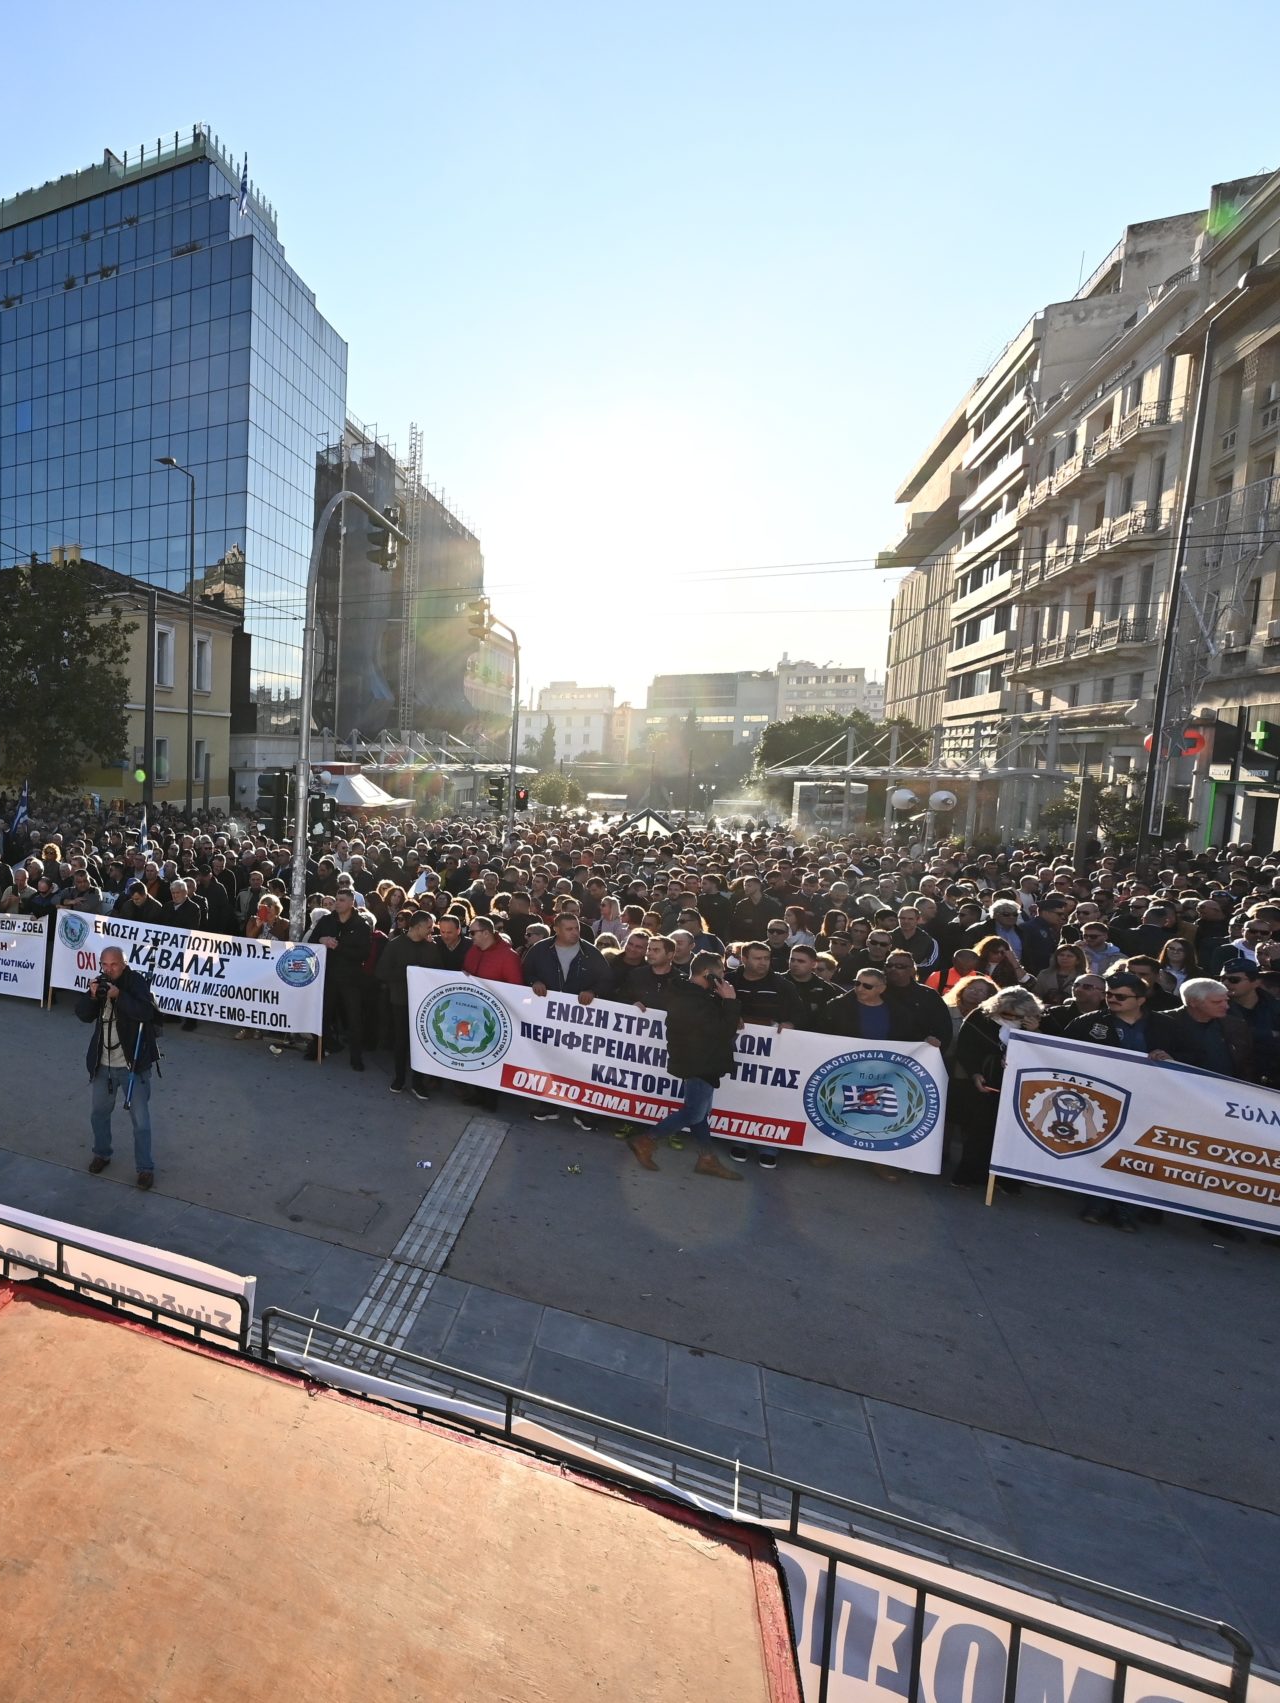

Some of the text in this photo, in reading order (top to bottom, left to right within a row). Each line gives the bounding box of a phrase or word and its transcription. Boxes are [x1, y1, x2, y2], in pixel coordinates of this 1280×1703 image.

[22, 921, 43, 934] ΣΟΕΔ
[94, 920, 139, 940] ΕΝΩΣΗ
[142, 928, 242, 956] ΣΤΡΑΤΙΩΤΙΚΩΝ
[76, 950, 97, 970] ΟΧΙ
[129, 943, 230, 979] ΚΑΒΑΛΑΣ
[201, 983, 279, 1005] ΜΙΣΘΟΛΟΓΙΚΗ
[546, 1000, 609, 1029] ΕΝΩΣΗ
[520, 1021, 669, 1068] ΠΕΡΙΦΕΡΕΙΑΚΗ
[512, 1070, 548, 1092] ΟΧΙ
[548, 1080, 581, 1100] ΣΤΟ
[581, 1090, 630, 1112] ΣΩΜΑ
[819, 1052, 884, 1075] ΟΜΟΣΠΟΝΔΙΑ
[910, 1083, 938, 1141] ΣΤΡΑΤΙΩΤΙΚΩΝ
[1151, 1128, 1200, 1155] Στις
[1119, 1156, 1155, 1174] και
